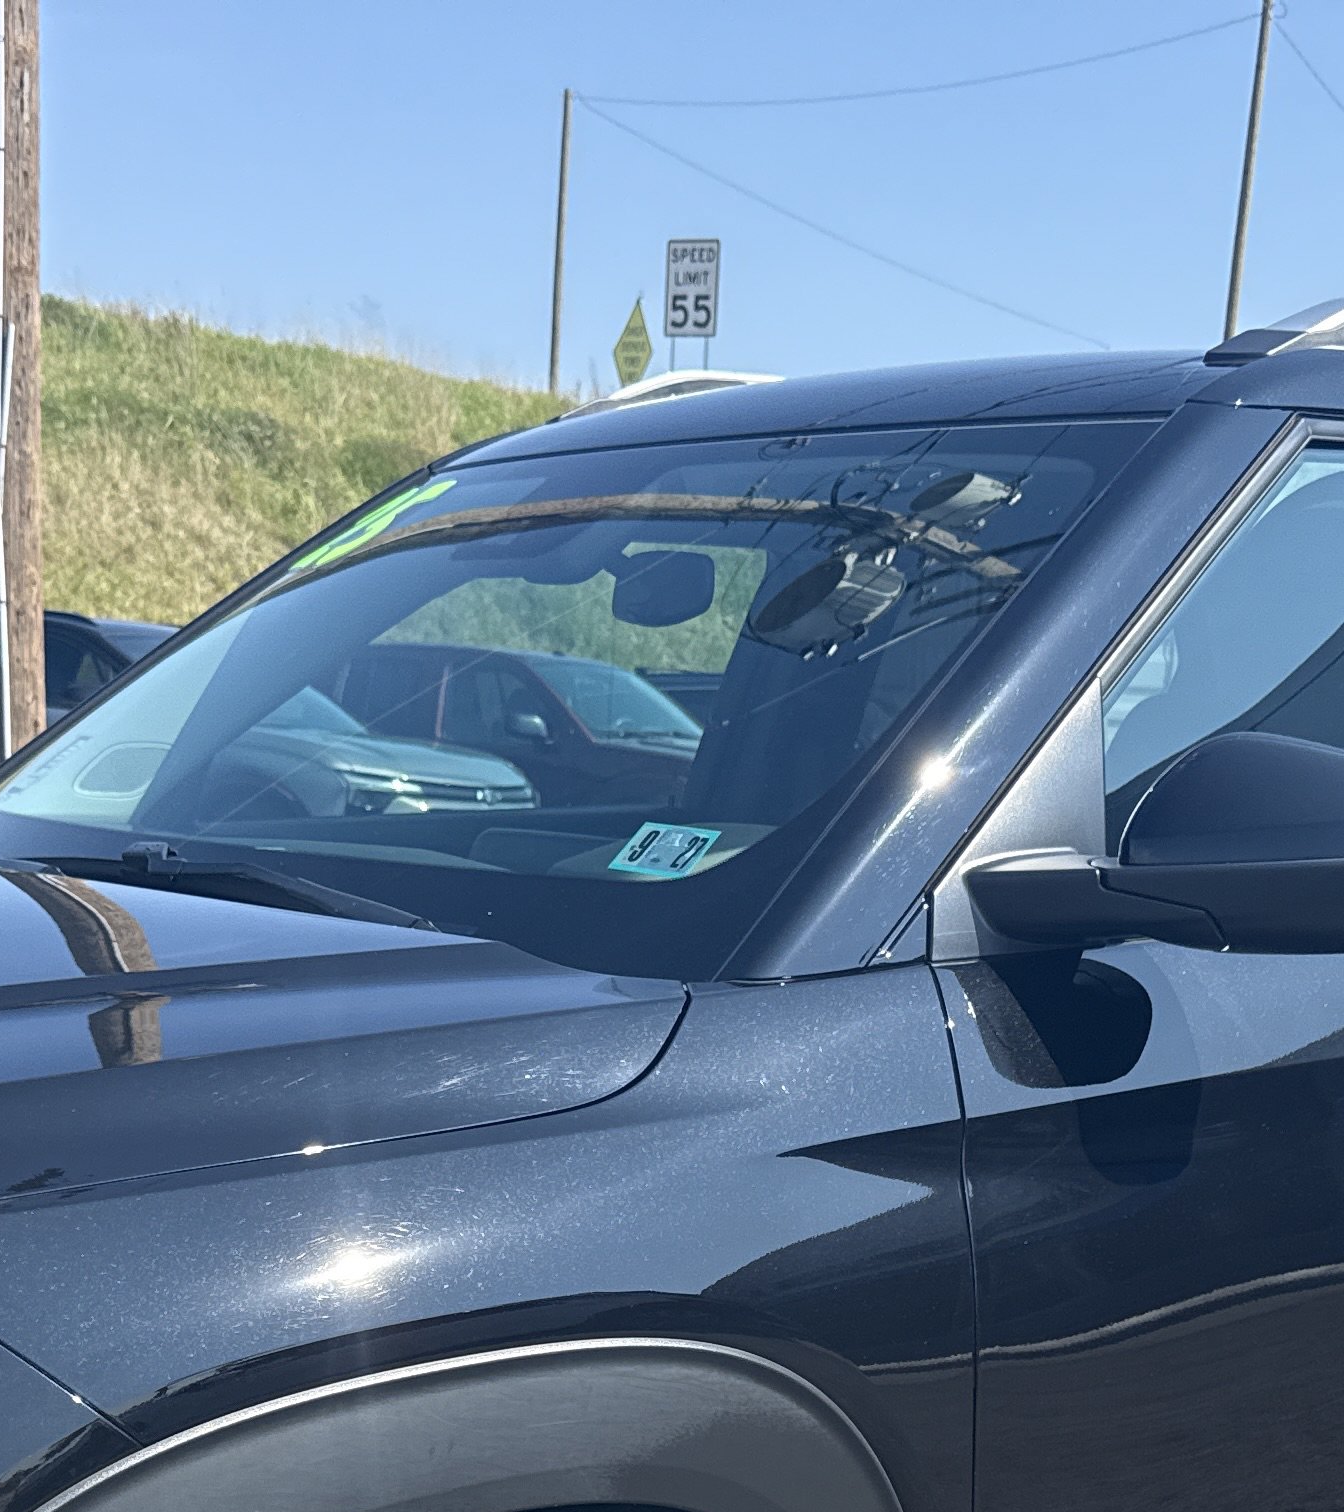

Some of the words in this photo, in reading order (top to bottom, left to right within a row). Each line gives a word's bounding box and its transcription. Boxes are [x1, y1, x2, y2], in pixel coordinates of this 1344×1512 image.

[671, 247, 716, 263] SPEED
[674, 270, 709, 287] LIMIT
[670, 294, 711, 328] 55
[670, 836, 710, 869] 27
